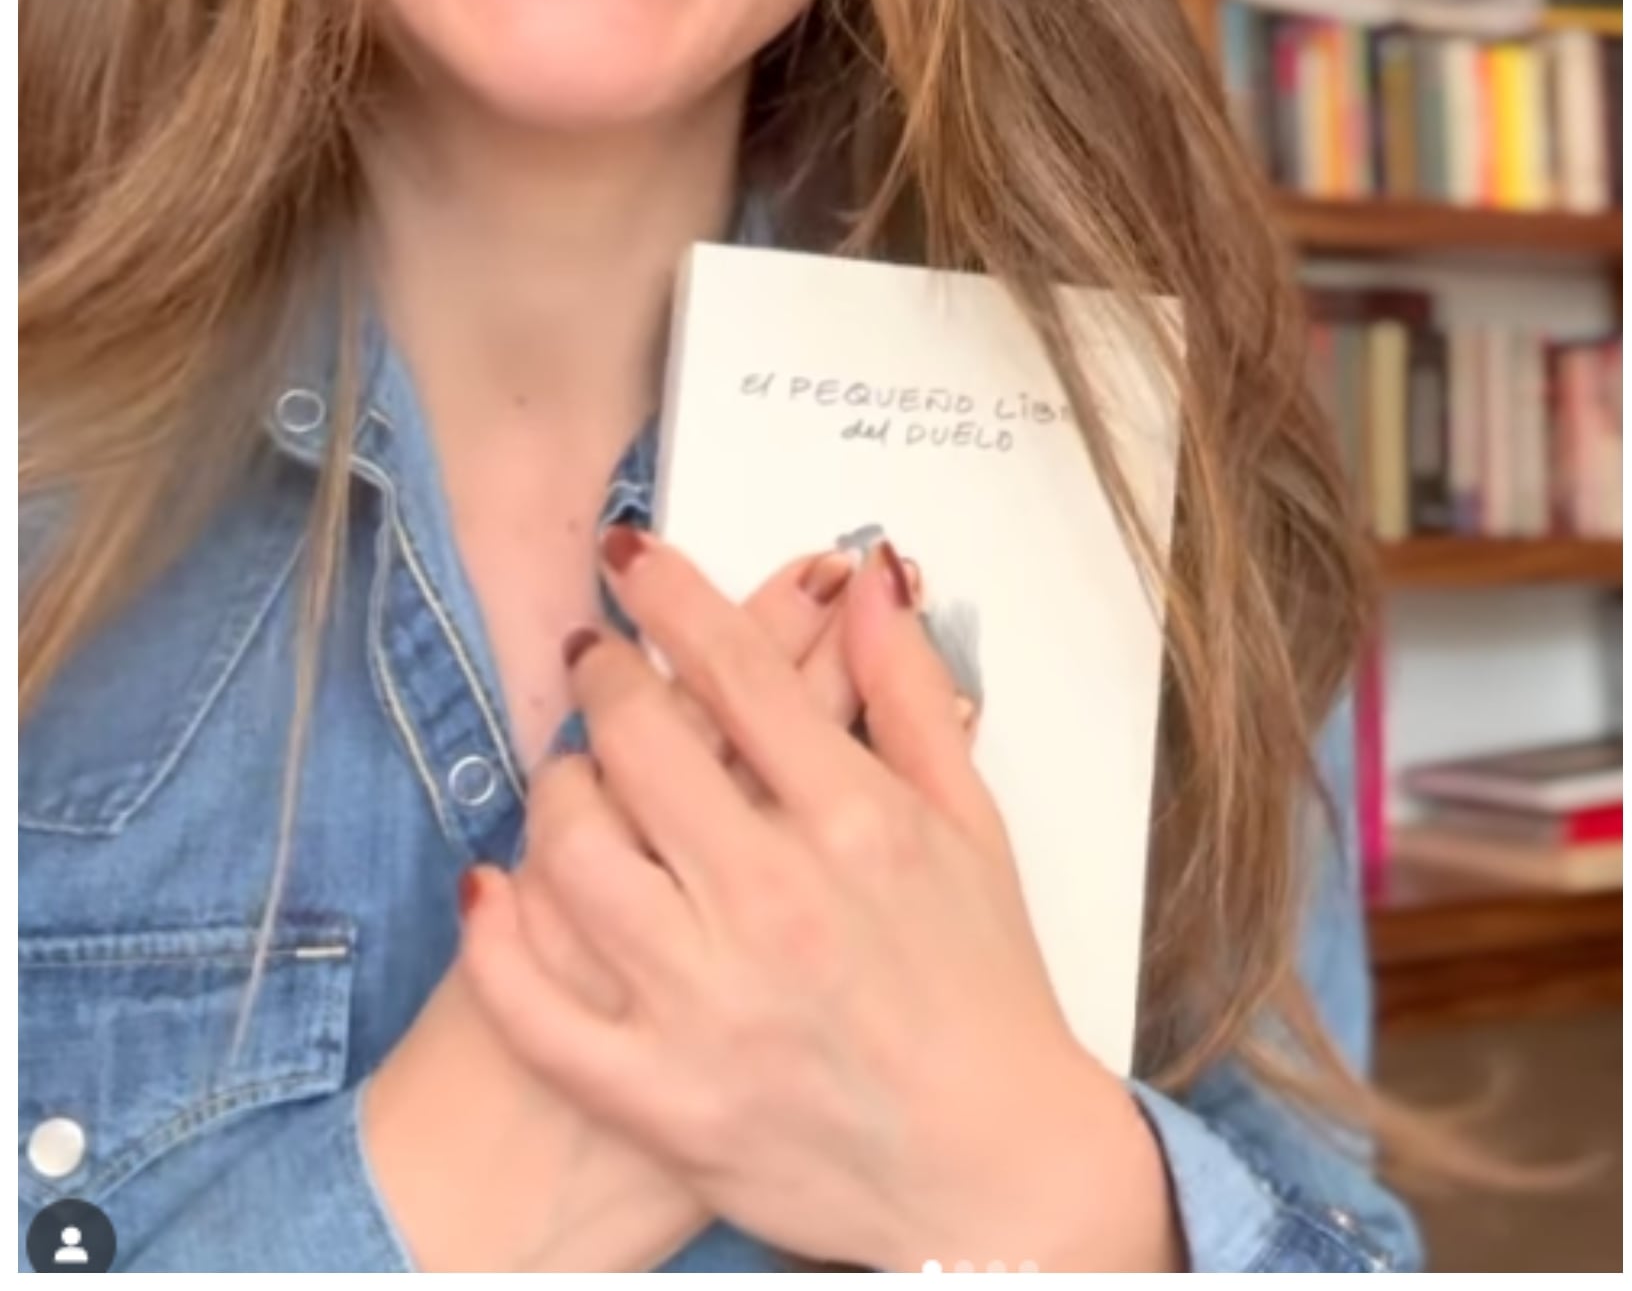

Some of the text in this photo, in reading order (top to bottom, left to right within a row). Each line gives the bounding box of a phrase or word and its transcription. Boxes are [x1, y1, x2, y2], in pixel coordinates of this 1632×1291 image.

[787, 375, 976, 416] PEQUEÑO
[839, 416, 1014, 453] del DUELO
